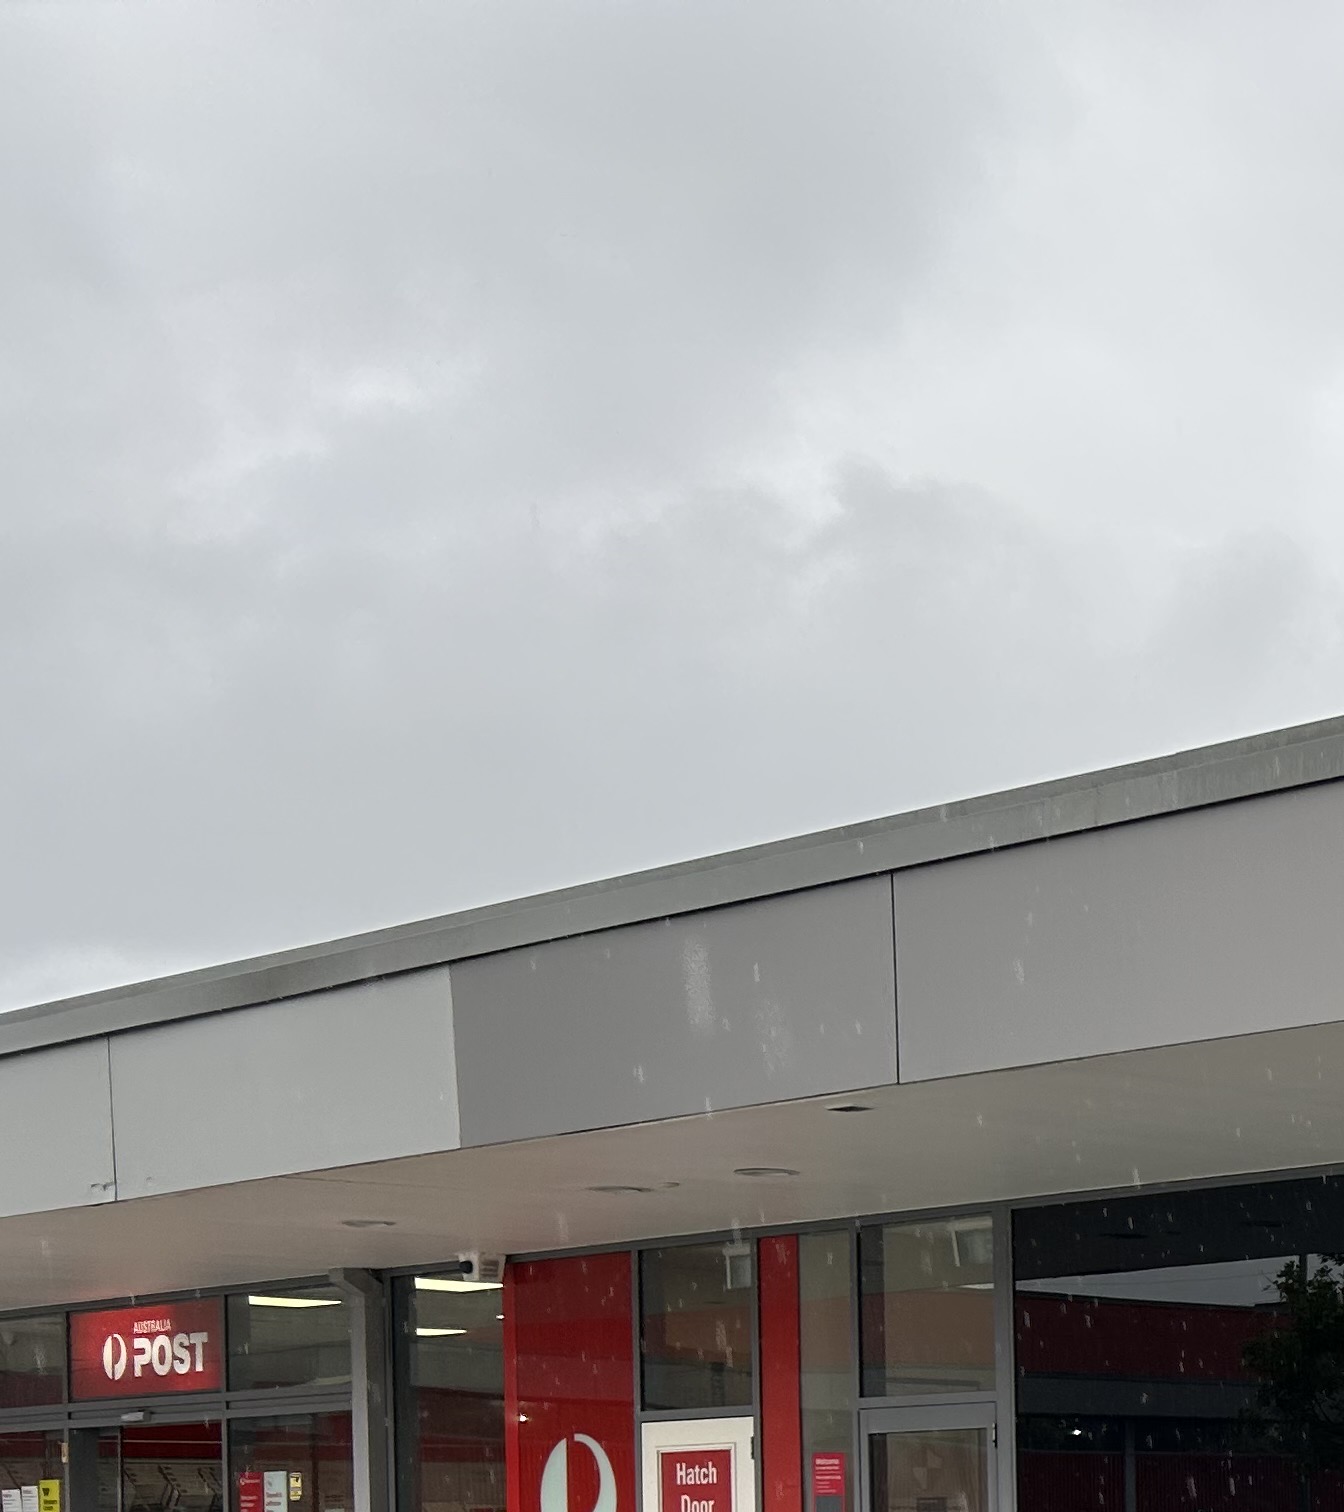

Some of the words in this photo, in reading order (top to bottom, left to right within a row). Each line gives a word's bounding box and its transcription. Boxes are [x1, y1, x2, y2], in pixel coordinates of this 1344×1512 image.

[133, 1319, 171, 1334] AUSTRALIA
[133, 1331, 208, 1378] POST
[676, 1461, 717, 1485] Hatch
